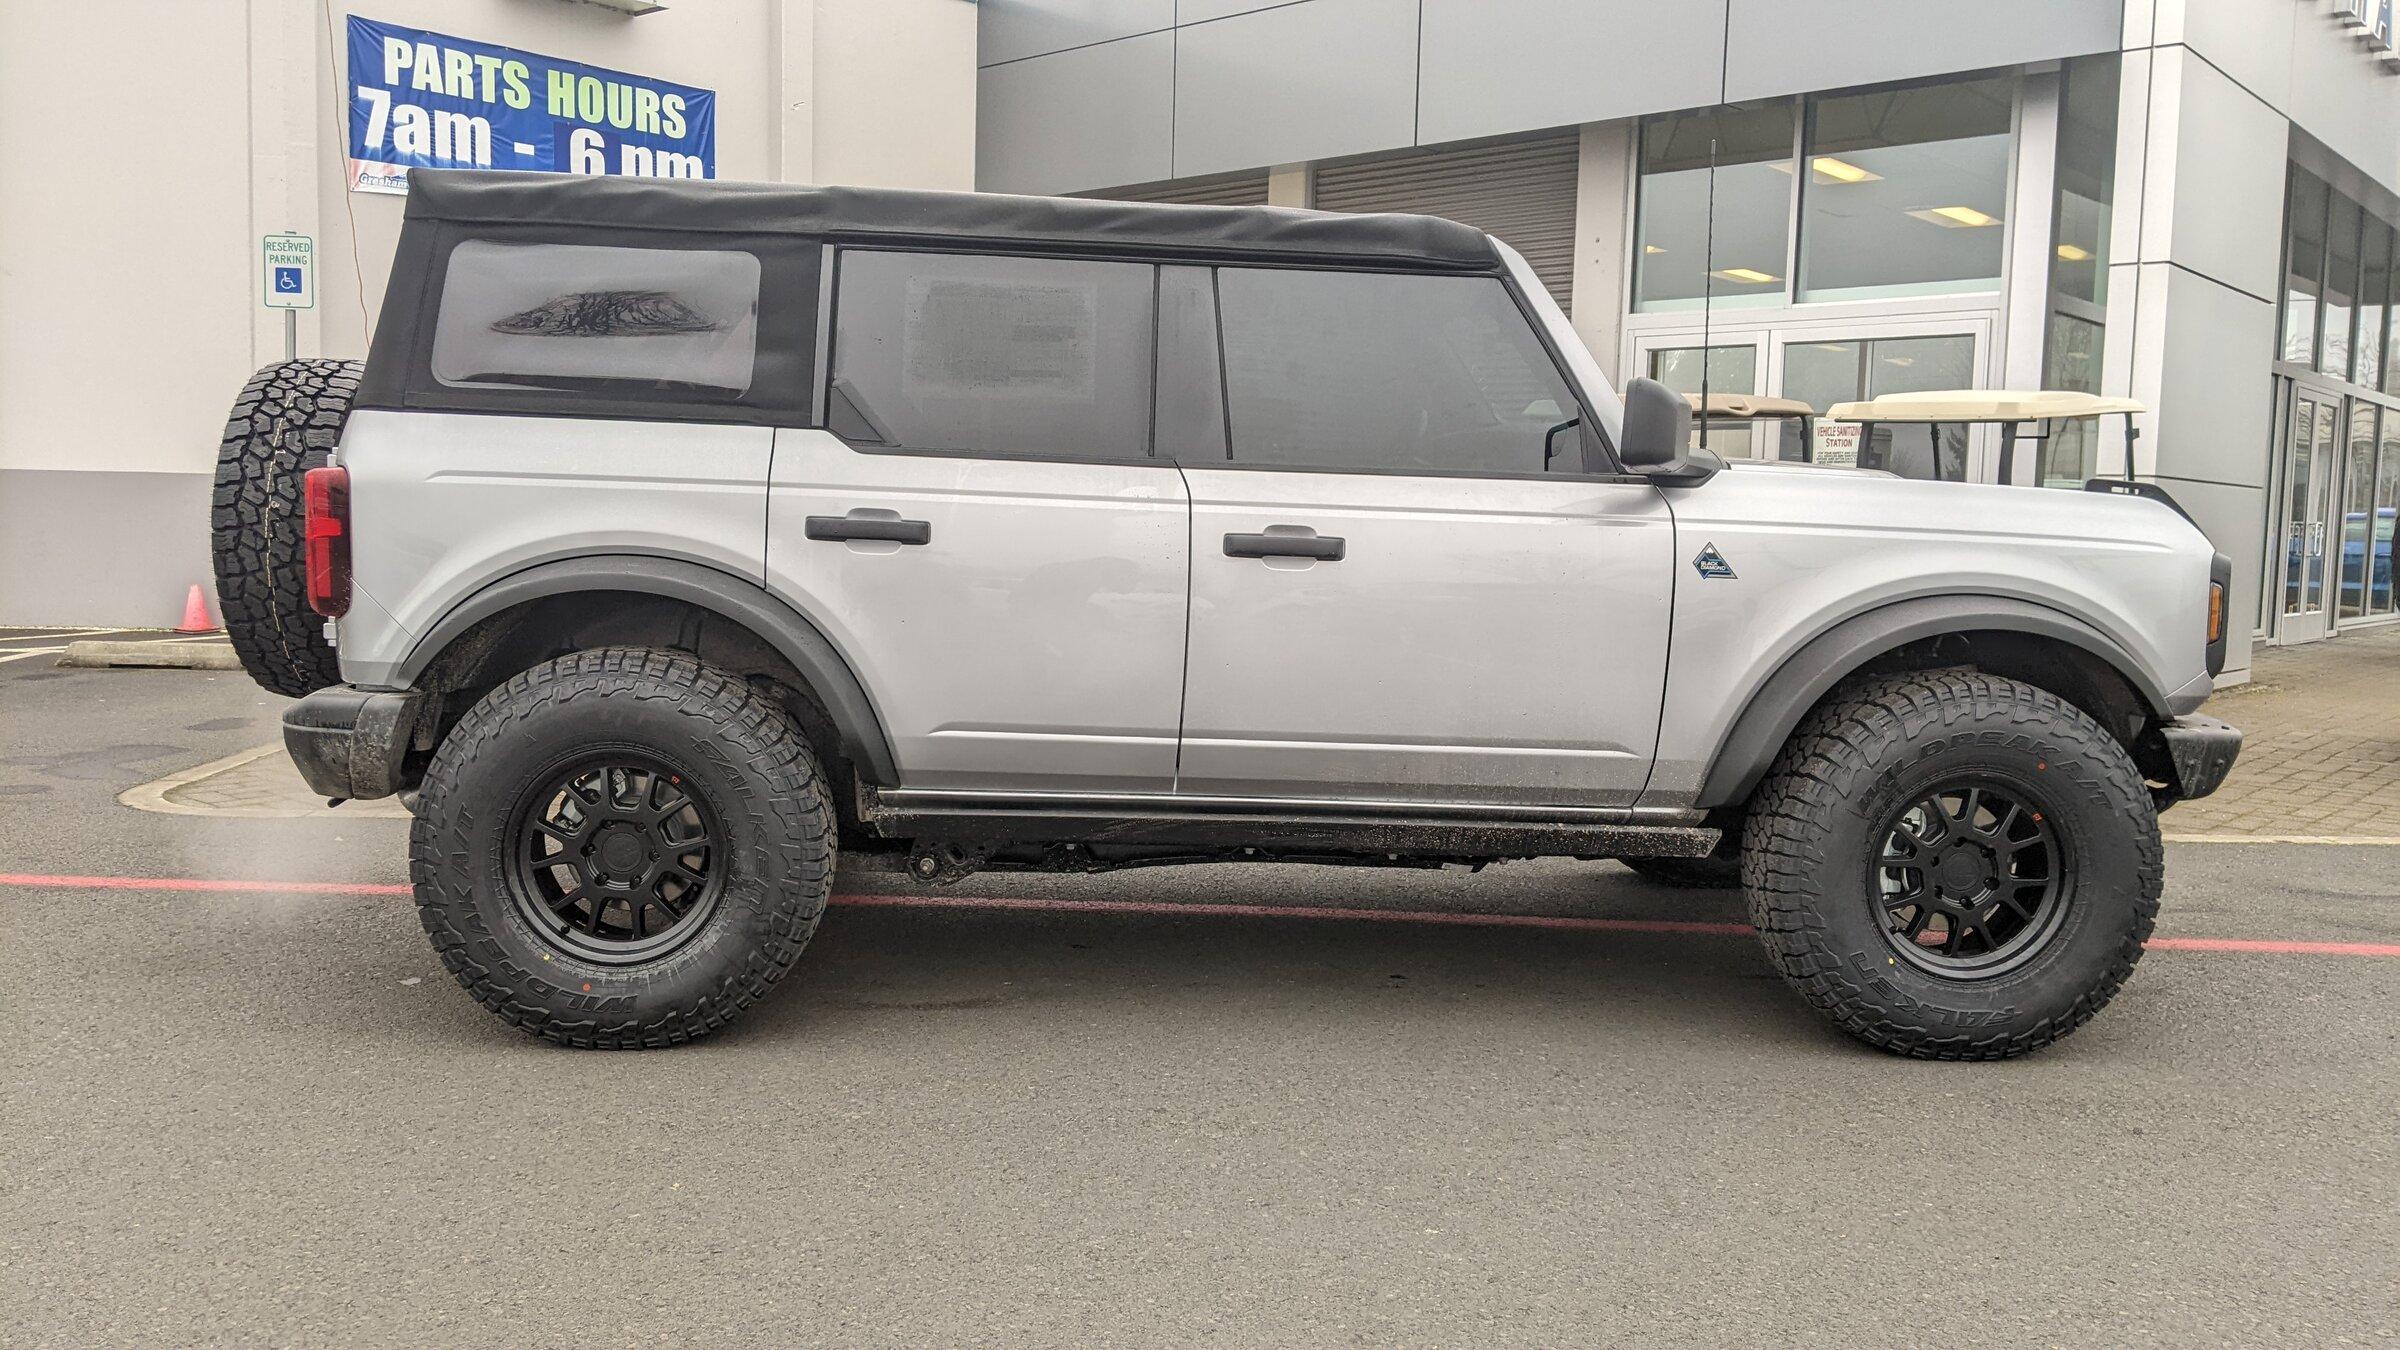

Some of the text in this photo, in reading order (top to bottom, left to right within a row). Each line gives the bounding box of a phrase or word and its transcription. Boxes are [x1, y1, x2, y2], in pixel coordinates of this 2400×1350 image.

[384, 36, 686, 139] PARTS HOURS
[357, 86, 492, 166] 7am
[569, 128, 605, 174] 6
[266, 241, 310, 253] RESERVED
[269, 254, 308, 265] PARKING
[1817, 426, 1836, 437] VEHICLE
[1825, 438, 1853, 448] STATION
